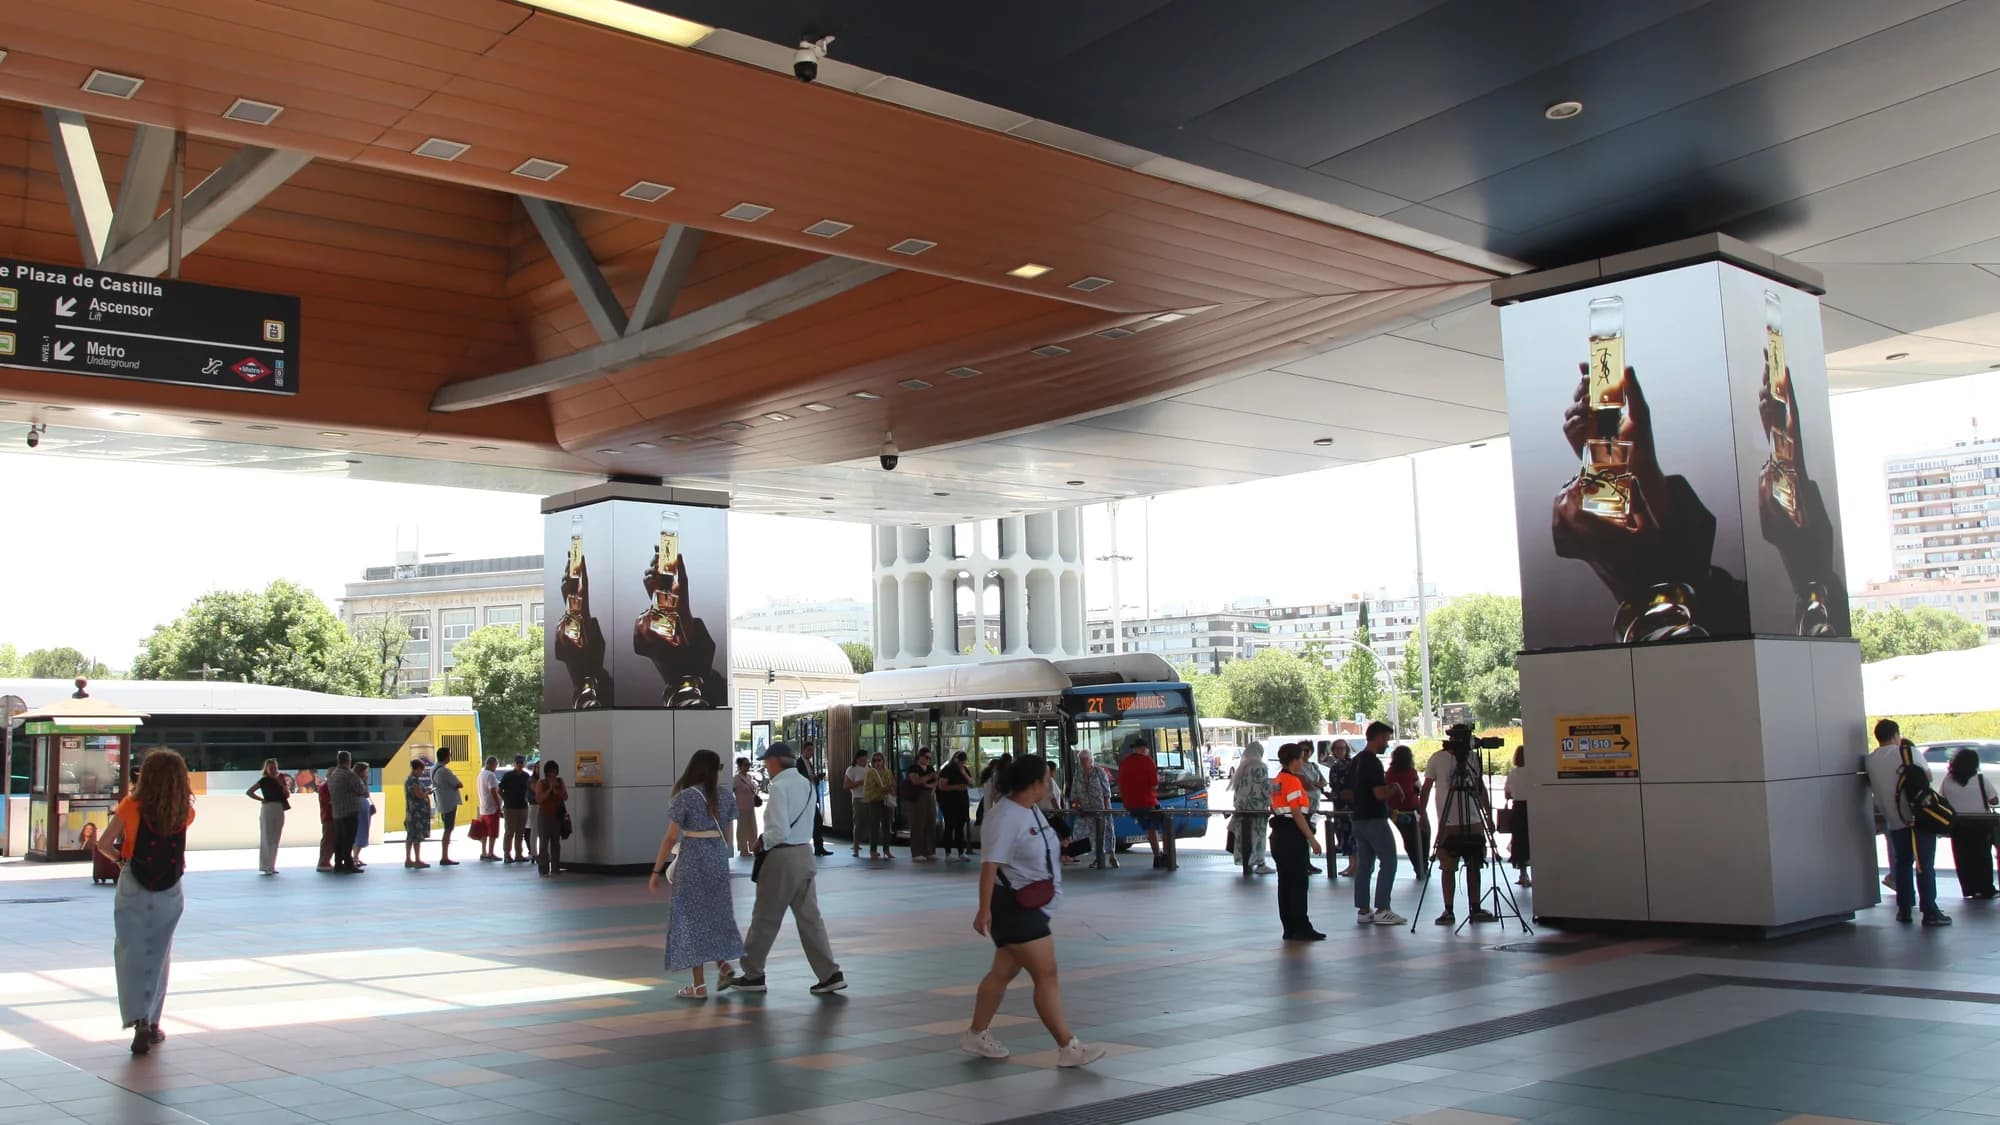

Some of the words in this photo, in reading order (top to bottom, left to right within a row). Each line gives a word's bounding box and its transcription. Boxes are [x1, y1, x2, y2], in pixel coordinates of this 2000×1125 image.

[16, 266, 66, 285] Plaza
[73, 273, 94, 288] de
[100, 277, 163, 297] Castilla
[89, 298, 153, 318] Ascensor
[89, 311, 102, 322] Lift
[87, 341, 126, 358] Metro
[86, 356, 140, 369] Underground
[242, 365, 262, 375] Metro
[1087, 697, 1104, 713] 27
[1562, 739, 1574, 751] 10
